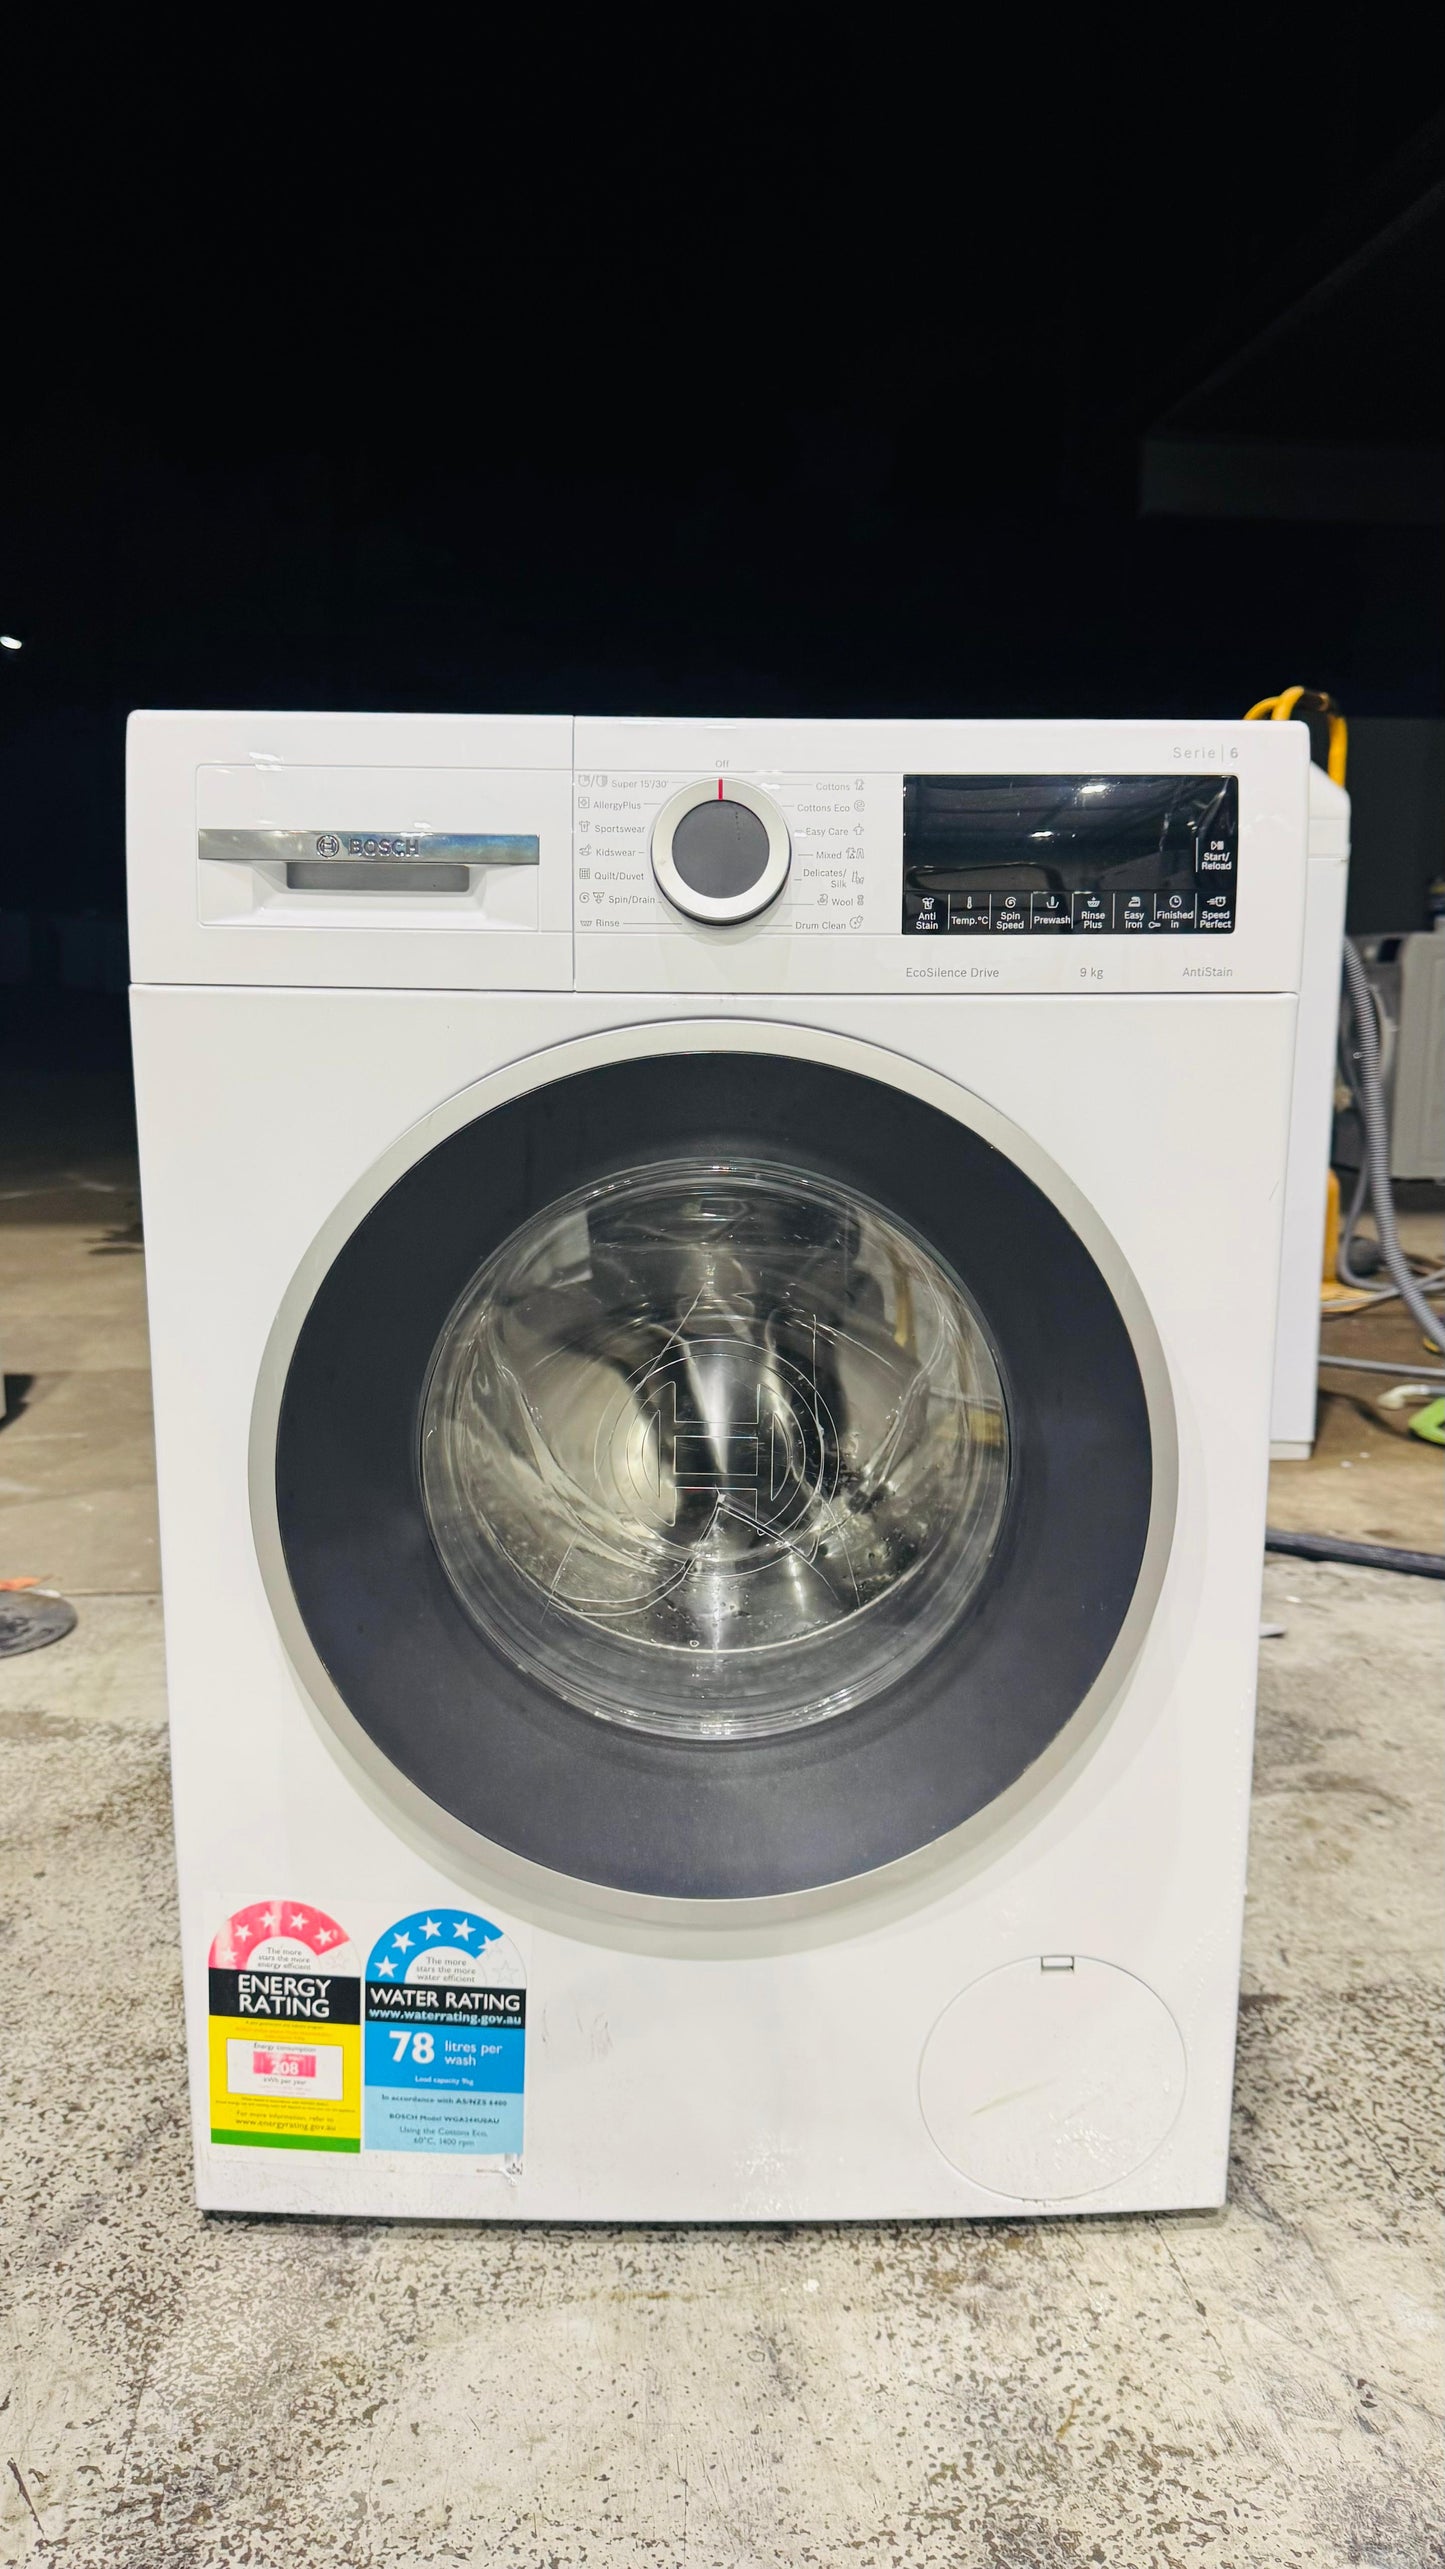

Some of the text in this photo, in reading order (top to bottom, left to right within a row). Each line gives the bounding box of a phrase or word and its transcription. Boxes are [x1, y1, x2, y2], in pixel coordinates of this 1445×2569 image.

[1173, 747, 1238, 759] Serie 6
[716, 760, 729, 768] Off
[612, 780, 637, 788] Super
[816, 783, 850, 791] Cottons
[593, 801, 641, 810] AllergyPlus
[797, 804, 850, 812] Cottons Eco
[594, 825, 645, 833] Sportswear
[806, 828, 825, 836] Easy
[348, 838, 419, 857] BOSCH
[816, 851, 842, 859] Mixed
[1204, 852, 1230, 861] Start/
[1201, 862, 1232, 870] Reload
[594, 872, 644, 881] Quilt/Duvet
[803, 869, 847, 877] Delicates/
[831, 880, 847, 888] Silk
[608, 896, 655, 904] Spin/Drain
[832, 898, 853, 906] Wool
[918, 912, 936, 921] Anti
[1000, 912, 1020, 921] Spin
[1082, 911, 1105, 919] Rinse
[1124, 912, 1144, 920] Easy
[1157, 911, 1193, 919] Finished
[1202, 911, 1230, 920] Speed
[1034, 916, 1071, 924] Prewash
[1084, 920, 1102, 929] Plus
[1125, 920, 1143, 928] Iron
[1171, 920, 1179, 928] in
[1200, 920, 1231, 928] Perfect
[822, 921, 846, 929] Clean
[916, 921, 938, 930] Stain
[997, 921, 1024, 930] Speed
[906, 967, 1000, 977] EcoSilence Drive
[1080, 968, 1103, 979] 9 kg
[1183, 967, 1233, 977] AntiStain
[426, 1957, 467, 1967] The more
[238, 1974, 331, 1998] ENERGY
[370, 1988, 520, 2011] WATER RATING
[239, 1994, 329, 2018] RATING
[369, 2008, 521, 2026] www.waterrating.gov.au
[389, 2030, 435, 2064] 78
[445, 2040, 502, 2056] litres per
[445, 2055, 476, 2066] wash
